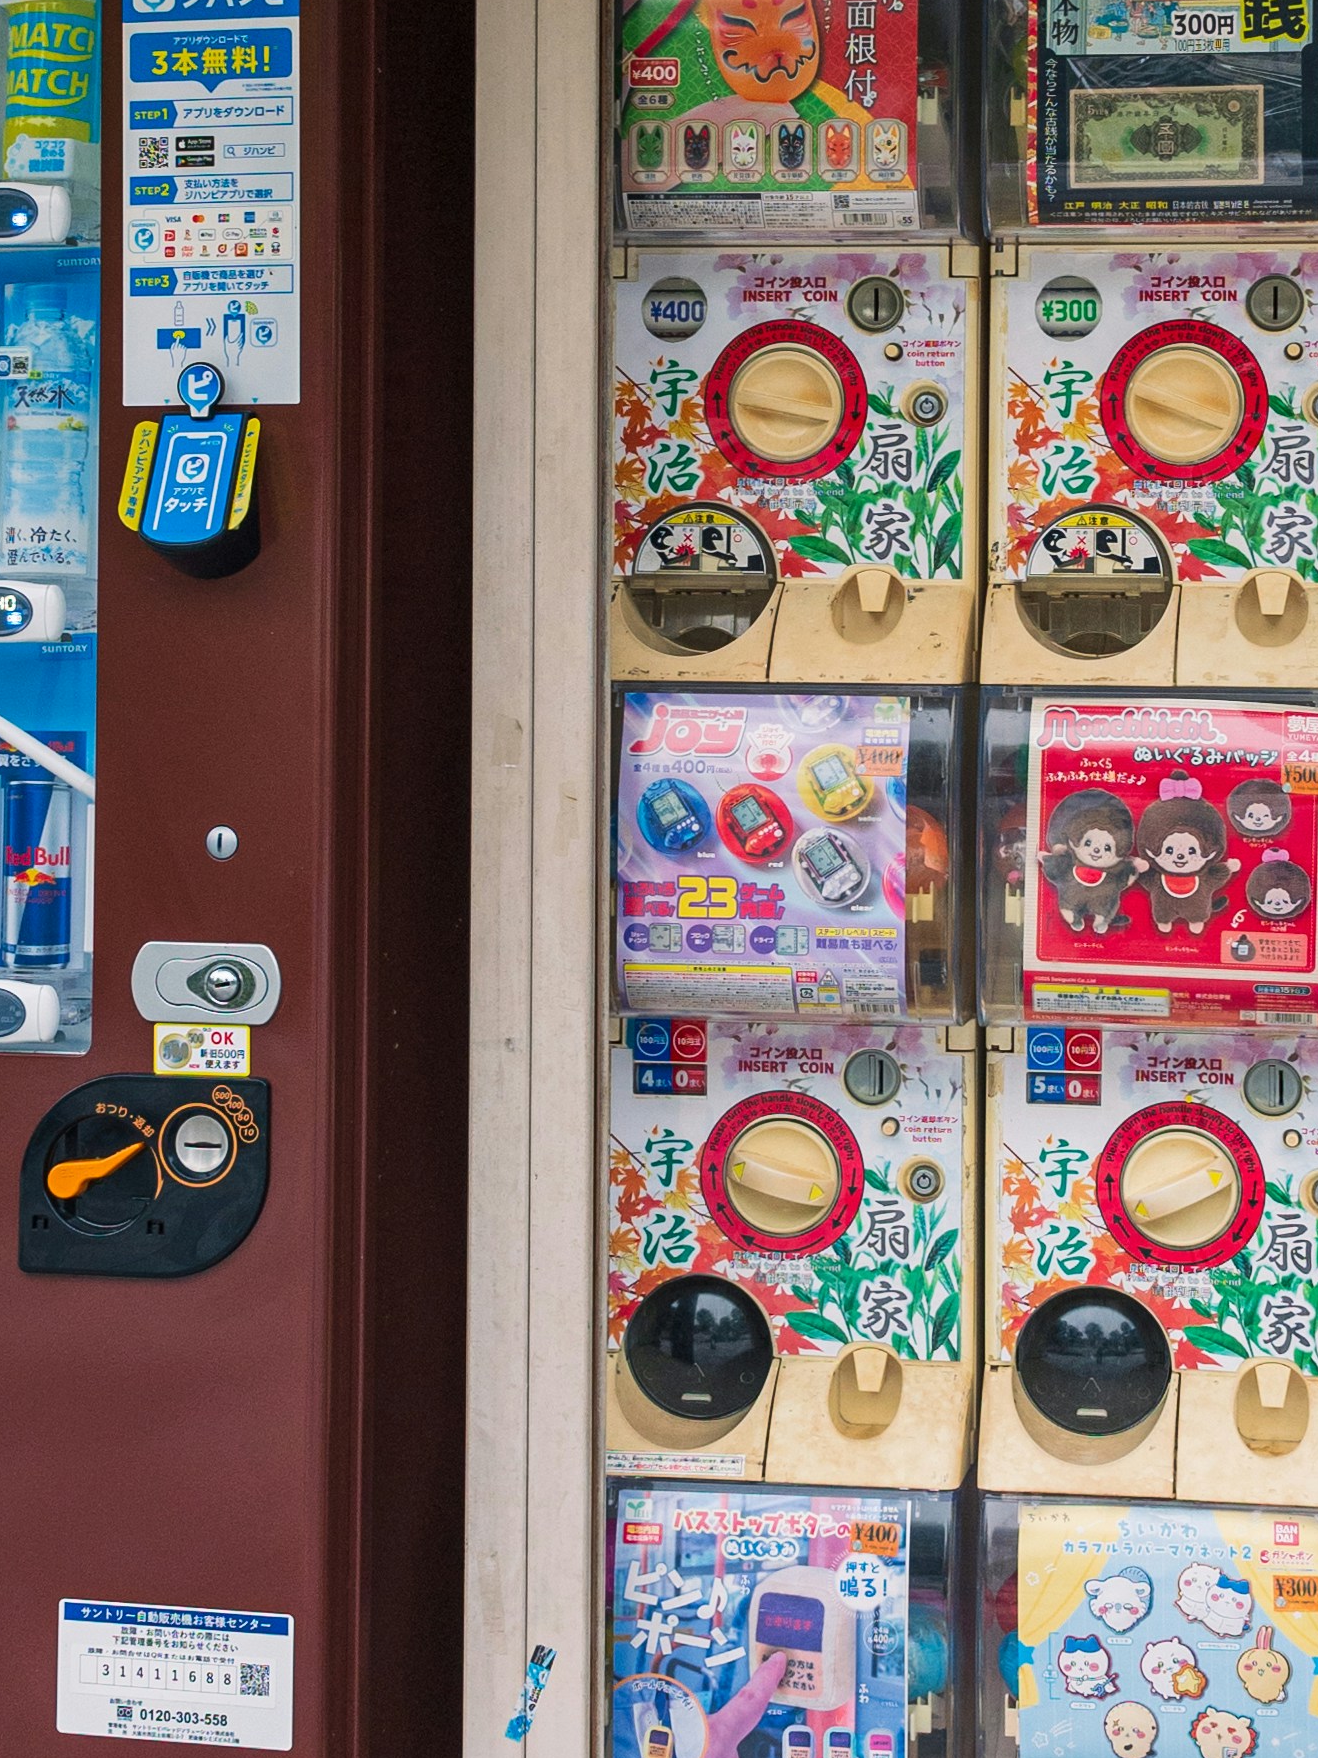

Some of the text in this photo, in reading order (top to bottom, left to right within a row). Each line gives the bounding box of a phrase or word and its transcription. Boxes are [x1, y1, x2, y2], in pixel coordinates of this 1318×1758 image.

[1172, 12, 1235, 36] 300円
[151, 45, 271, 77] 3本無料!
[632, 63, 677, 84] ¥400
[637, 93, 670, 107] 全6種
[134, 106, 169, 121] STEP1
[182, 104, 286, 120] アプリをダウンロード
[134, 183, 170, 197] STEP2
[183, 178, 239, 190] 支払い方法を
[184, 188, 273, 201] ジハンピアプリで選択
[1090, 200, 1113, 211] 明治
[1118, 200, 1141, 211] 大正
[1145, 200, 1169, 211] 昭和
[134, 275, 170, 289] STEP3
[182, 268, 265, 281] 自販機で商品を選び
[182, 280, 270, 293] アプリを開いてタッチ
[752, 276, 827, 291] コイン投入口
[1149, 275, 1227, 290] コイン投入口
[742, 289, 838, 303] INSERT COIN
[1138, 288, 1238, 303] INSERT COIN
[649, 300, 705, 323] ¥400
[1041, 299, 1098, 323] ¥300
[906, 349, 956, 359] coin return
[915, 358, 946, 368] button
[647, 358, 700, 497] 宇治
[1039, 359, 1097, 498] 宇治
[858, 423, 914, 561] 扇家
[163, 497, 210, 515] タッチ
[693, 511, 716, 525] 注意
[1088, 513, 1110, 527] 注意
[1036, 707, 1227, 751] Monchhichi
[1079, 758, 1113, 770] ふっくら
[1133, 746, 1279, 767] ぬいぐるみバッジ
[34, 844, 70, 865] Bull
[677, 875, 739, 920] 23
[815, 938, 898, 952] 難易度も選べる!
[210, 1030, 235, 1046] OK
[200, 1048, 245, 1060] 新旧500円
[748, 1046, 824, 1061] コイン投入口
[204, 1059, 241, 1071] 使えます
[737, 1060, 835, 1075] INSERT COIN
[1134, 1069, 1187, 1084] INSERT
[95, 1102, 156, 1138] おつり・返却
[673, 1509, 852, 1538] バスストップボタンの
[1117, 1518, 1200, 1540] ちいかわ
[725, 1541, 798, 1558] ぬいぐるみ
[1062, 1539, 1253, 1562] カラフルラバーマグネット2
[1271, 1550, 1314, 1562] ガシャポン
[844, 1560, 881, 1575] 押すと
[839, 1577, 890, 1598] 鳴る!
[1274, 1577, 1318, 1598] ¥300
[80, 1606, 272, 1630] サントリー自動販売機お客様センター
[112, 1635, 240, 1653] 下記管理番号をお知らせください
[629, 1610, 747, 1668] ポーン
[139, 1708, 229, 1727] 0120-303-558
